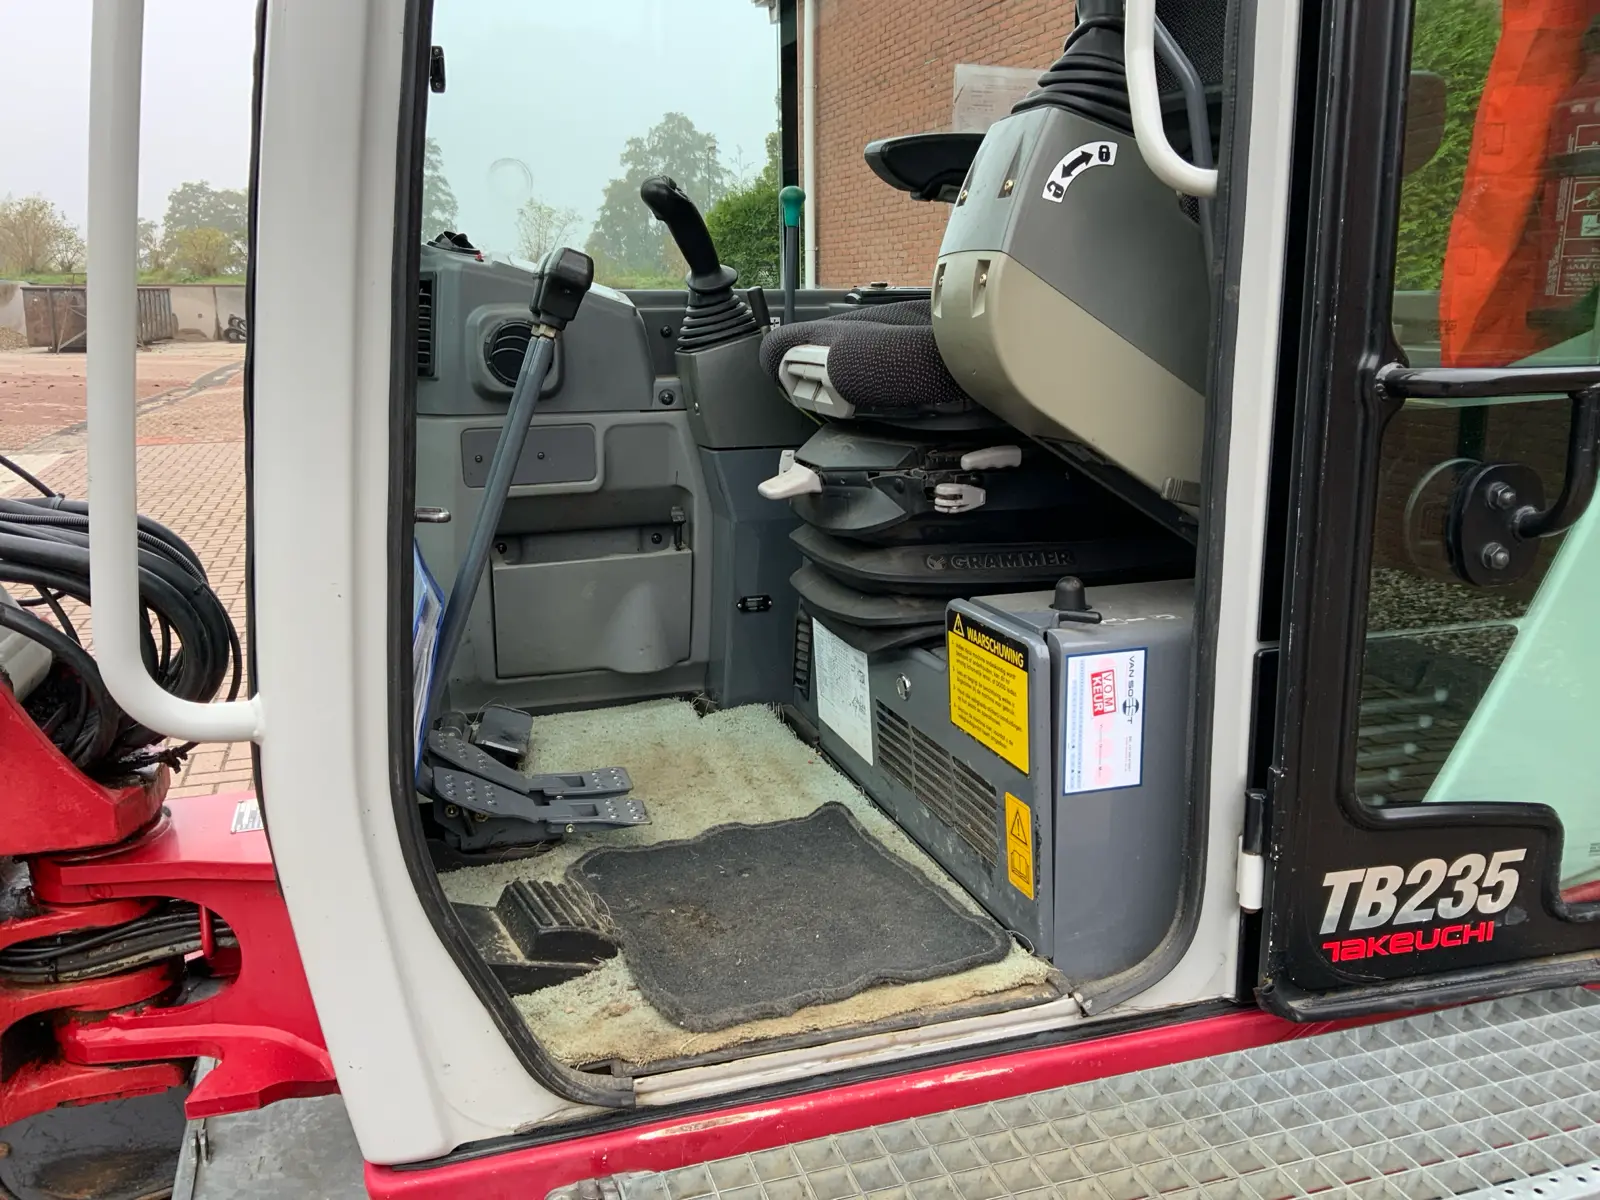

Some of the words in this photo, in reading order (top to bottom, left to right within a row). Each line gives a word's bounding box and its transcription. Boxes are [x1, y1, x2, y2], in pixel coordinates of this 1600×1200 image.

[951, 551, 1074, 569] GRAMMER
[966, 626, 1024, 668] WAARSCHUWING
[1092, 676, 1104, 712] KEUR
[1319, 848, 1527, 934] TB235
